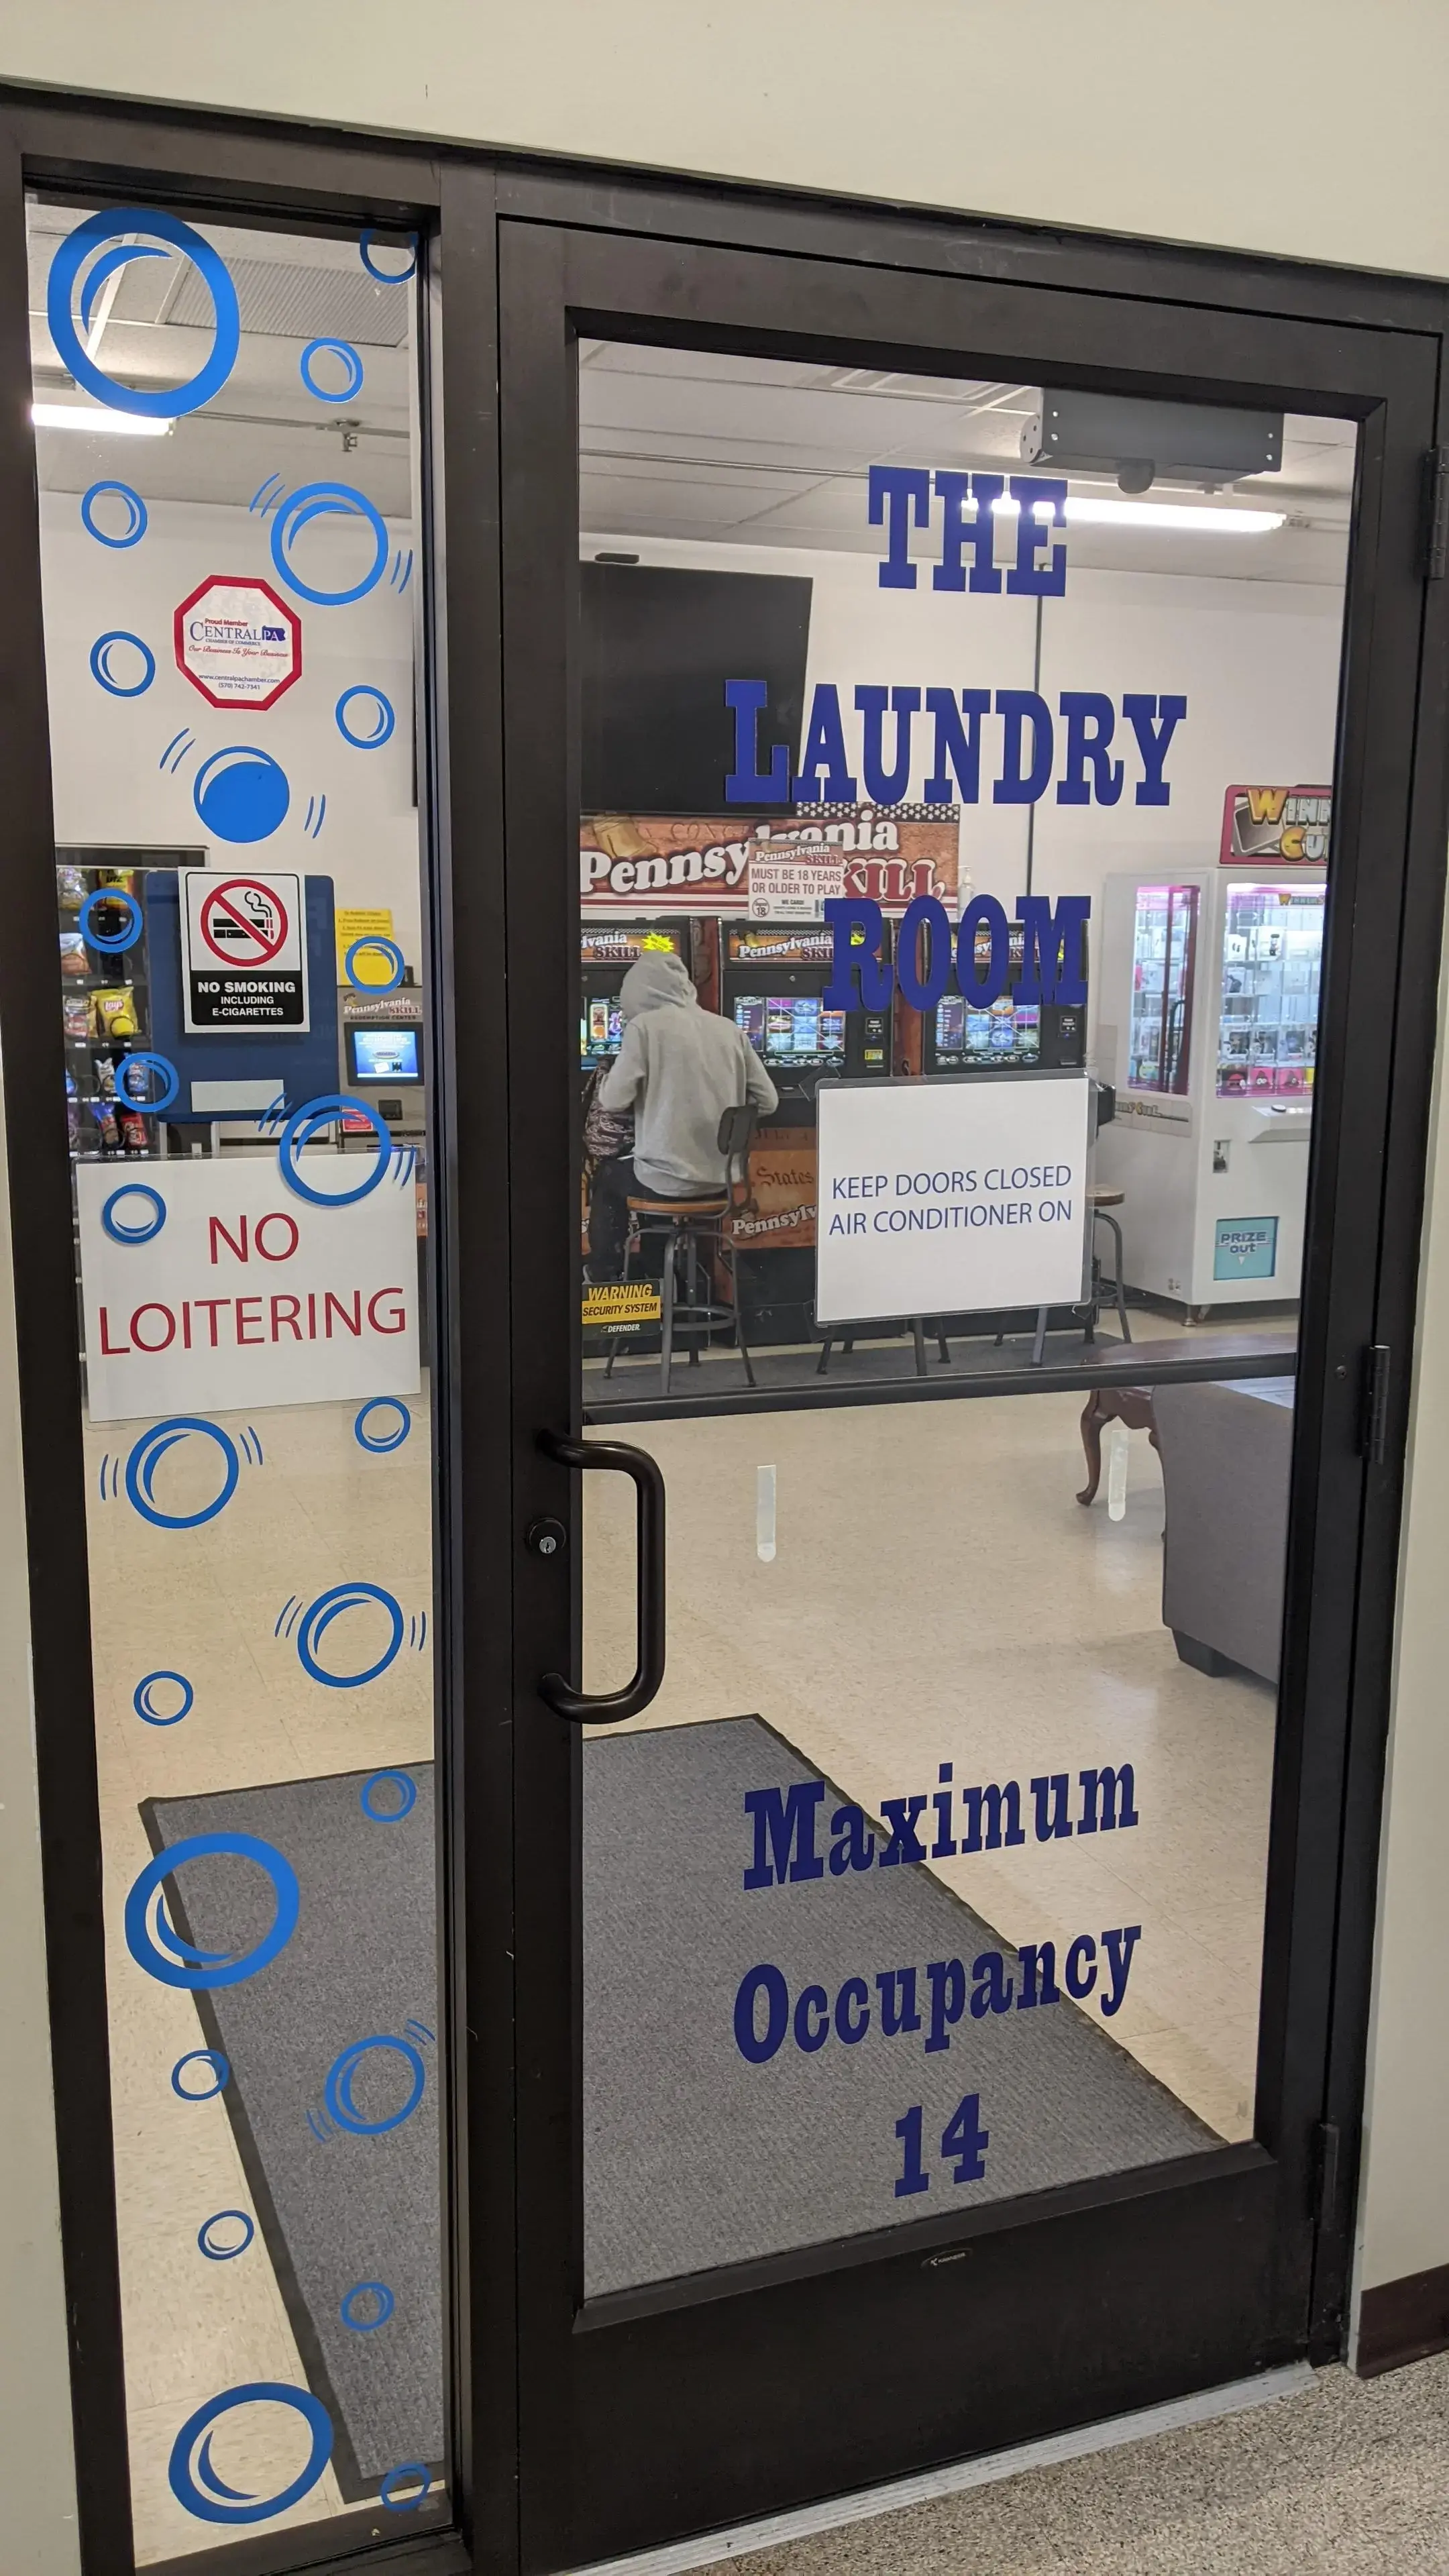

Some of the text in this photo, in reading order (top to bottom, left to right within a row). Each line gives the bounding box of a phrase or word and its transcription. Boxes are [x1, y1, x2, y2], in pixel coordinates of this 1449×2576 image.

[868, 465, 1068, 597] THE
[190, 621, 262, 641] CENTRAL
[223, 619, 248, 627] Member
[203, 645, 231, 654] Business
[241, 647, 259, 657] Your
[260, 648, 288, 657] Business
[199, 674, 280, 684] www.centralpachamber.com
[233, 682, 260, 690] 742-7341
[725, 680, 1187, 806] LAUNDRY
[755, 842, 830, 861] Pennsylvania
[805, 854, 843, 865] SKILL
[751, 868, 842, 881] MUST BE 18 YEARS
[752, 882, 841, 895] OR OLDER TO PLAY
[756, 906, 766, 916] 18
[581, 931, 627, 949] lvania
[739, 932, 833, 958] Pennsylvania
[595, 945, 643, 960] SKILL
[822, 894, 1091, 1012] ROOM
[197, 981, 296, 993] NO SMOKING
[221, 996, 274, 1005] INCLUDING
[343, 997, 411, 1014] Pennsylvania
[212, 1007, 284, 1016] E-CIGARETTES
[388, 1006, 422, 1015] SKILL
[757, 1165, 814, 1187] States
[833, 1165, 1072, 1199] KEEP DOORS CLOSED
[829, 1199, 1072, 1236] AIR CONDITIONER ON
[209, 1213, 299, 1265] NO
[1221, 1232, 1267, 1244] PRIZE
[588, 1283, 653, 1301] WARNING
[582, 1302, 658, 1317] SECURITY SYSTEM
[99, 1287, 407, 1355] LOITERING
[607, 1323, 641, 1333] DEFENDER
[743, 1762, 1139, 1890] Maximum
[734, 1925, 1142, 2064] Occupancy
[895, 2092, 989, 2198] 14
